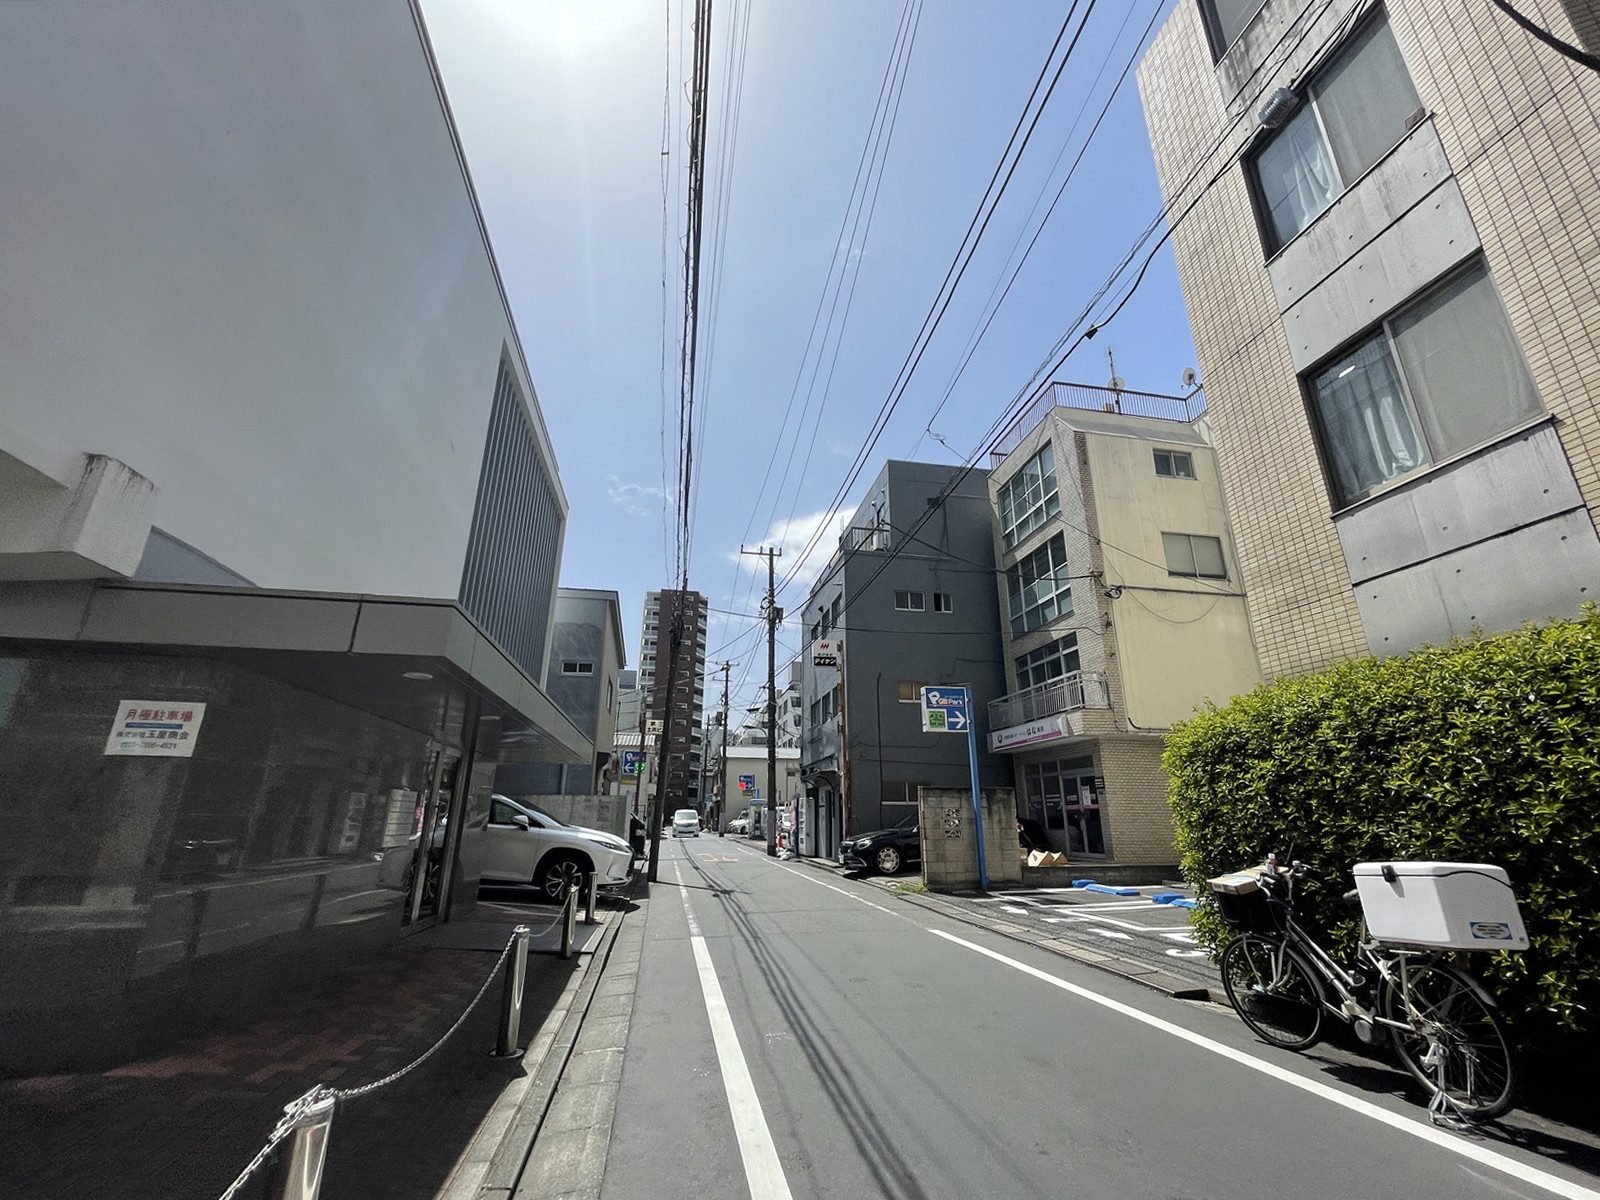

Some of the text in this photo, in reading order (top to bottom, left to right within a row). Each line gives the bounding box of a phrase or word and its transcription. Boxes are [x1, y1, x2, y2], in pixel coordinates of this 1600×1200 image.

[125, 709, 193, 722] 月極駐車場
